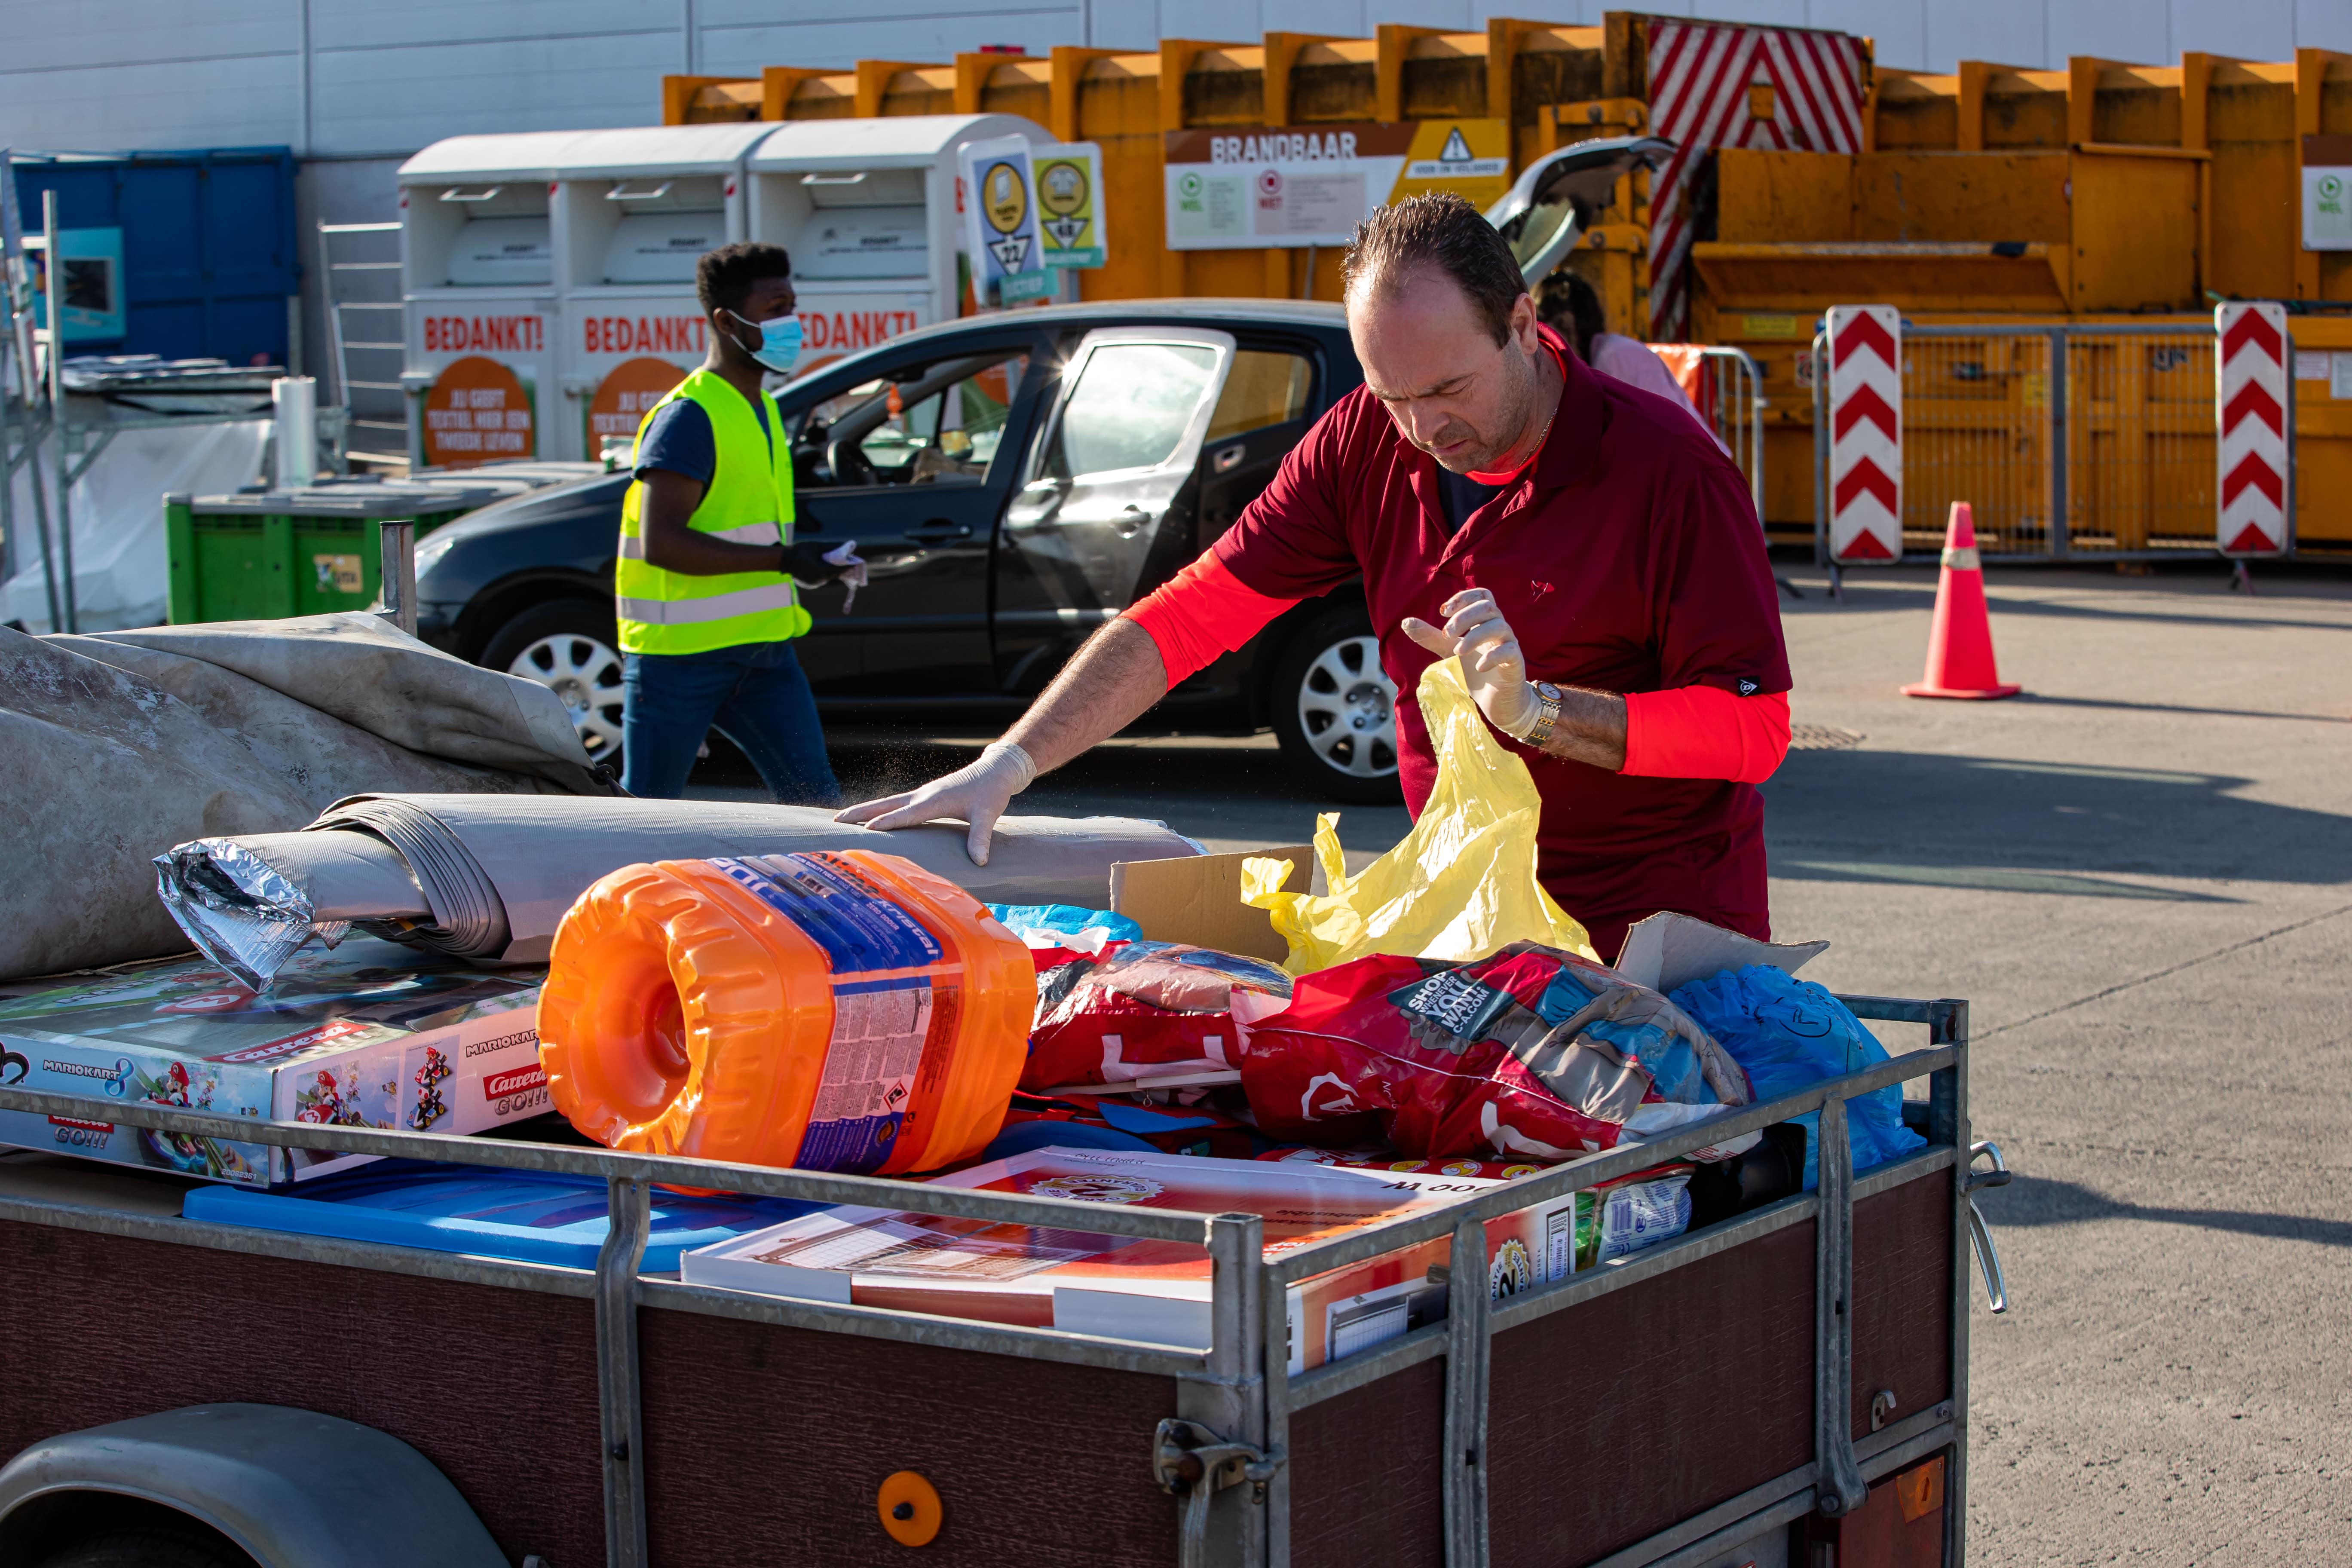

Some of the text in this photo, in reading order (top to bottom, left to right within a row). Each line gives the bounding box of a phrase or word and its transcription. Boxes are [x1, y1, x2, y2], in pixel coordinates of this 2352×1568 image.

[1210, 132, 1356, 162] BRANDBAAR
[424, 316, 544, 351] BEDANKT!
[585, 316, 707, 352] BEDANKT
[805, 858, 823, 873] QUALITY
[822, 868, 836, 881] FUELS
[866, 902, 881, 916] ZERO
[1408, 972, 1447, 1010] SHOP
[1419, 976, 1457, 1013] WHENEVER
[1425, 980, 1470, 1017] YOU
[1441, 986, 1481, 1028] WANT.
[1453, 988, 1490, 1033] C-A.COM
[223, 1025, 351, 1062] Carrera
[466, 1029, 539, 1058] MARIOKAR
[43, 1057, 135, 1097] MARIOKART 8
[489, 1069, 548, 1095] Carrera
[54, 1126, 109, 1149] GO!!!
[221, 1167, 257, 1181] 20062361
[1063, 1178, 1147, 1193] GUARANTEE
[1069, 1183, 1127, 1197] 2
[1275, 1210, 1382, 1219] combustible
[1499, 1269, 1515, 1299] 2
